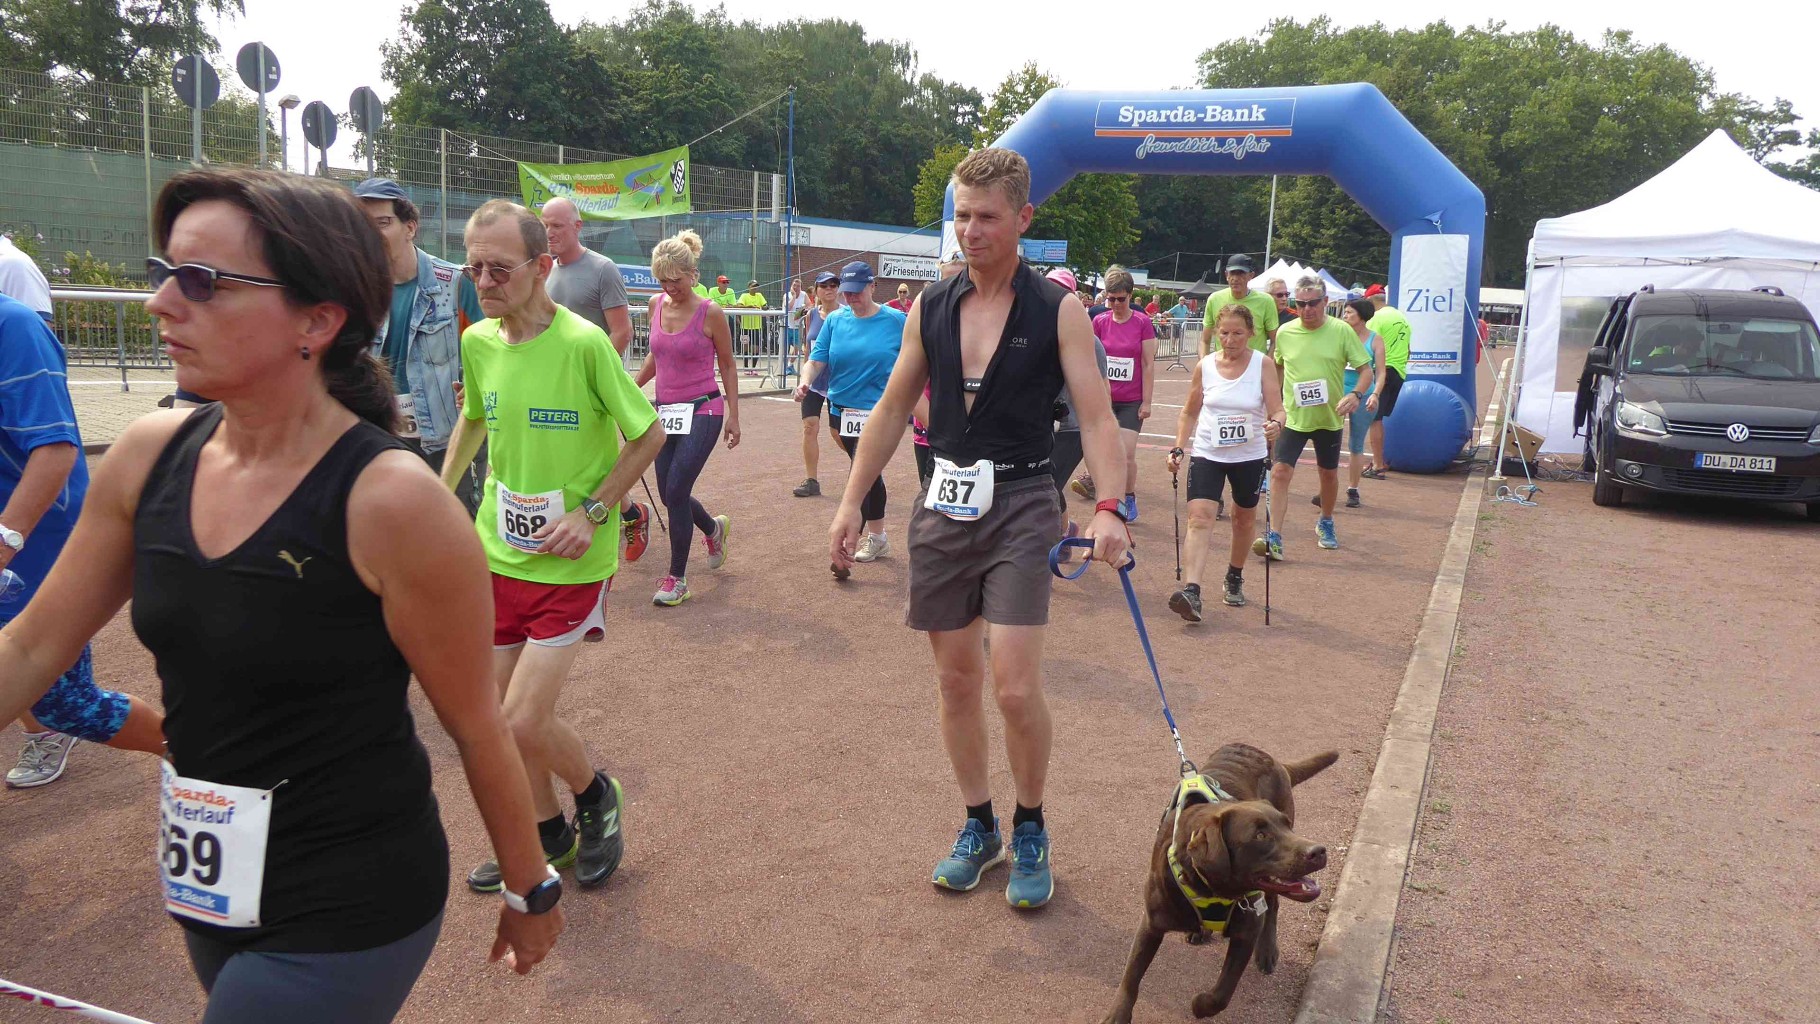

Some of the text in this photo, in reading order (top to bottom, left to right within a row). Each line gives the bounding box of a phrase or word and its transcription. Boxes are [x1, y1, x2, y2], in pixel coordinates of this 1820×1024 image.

[1118, 104, 1267, 127] Sparda-Bank
[1136, 133, 1221, 159] freundlich
[1234, 133, 1271, 160] fair
[892, 265, 936, 278] Friesenplatz
[1406, 288, 1454, 313] Ziel
[1107, 367, 1128, 379] 004
[1300, 388, 1321, 401] 645
[530, 410, 578, 422] PETERS
[1219, 425, 1246, 439] 670
[1703, 455, 1774, 471] DU DA 811
[937, 478, 976, 505] 637
[505, 509, 547, 538] 668
